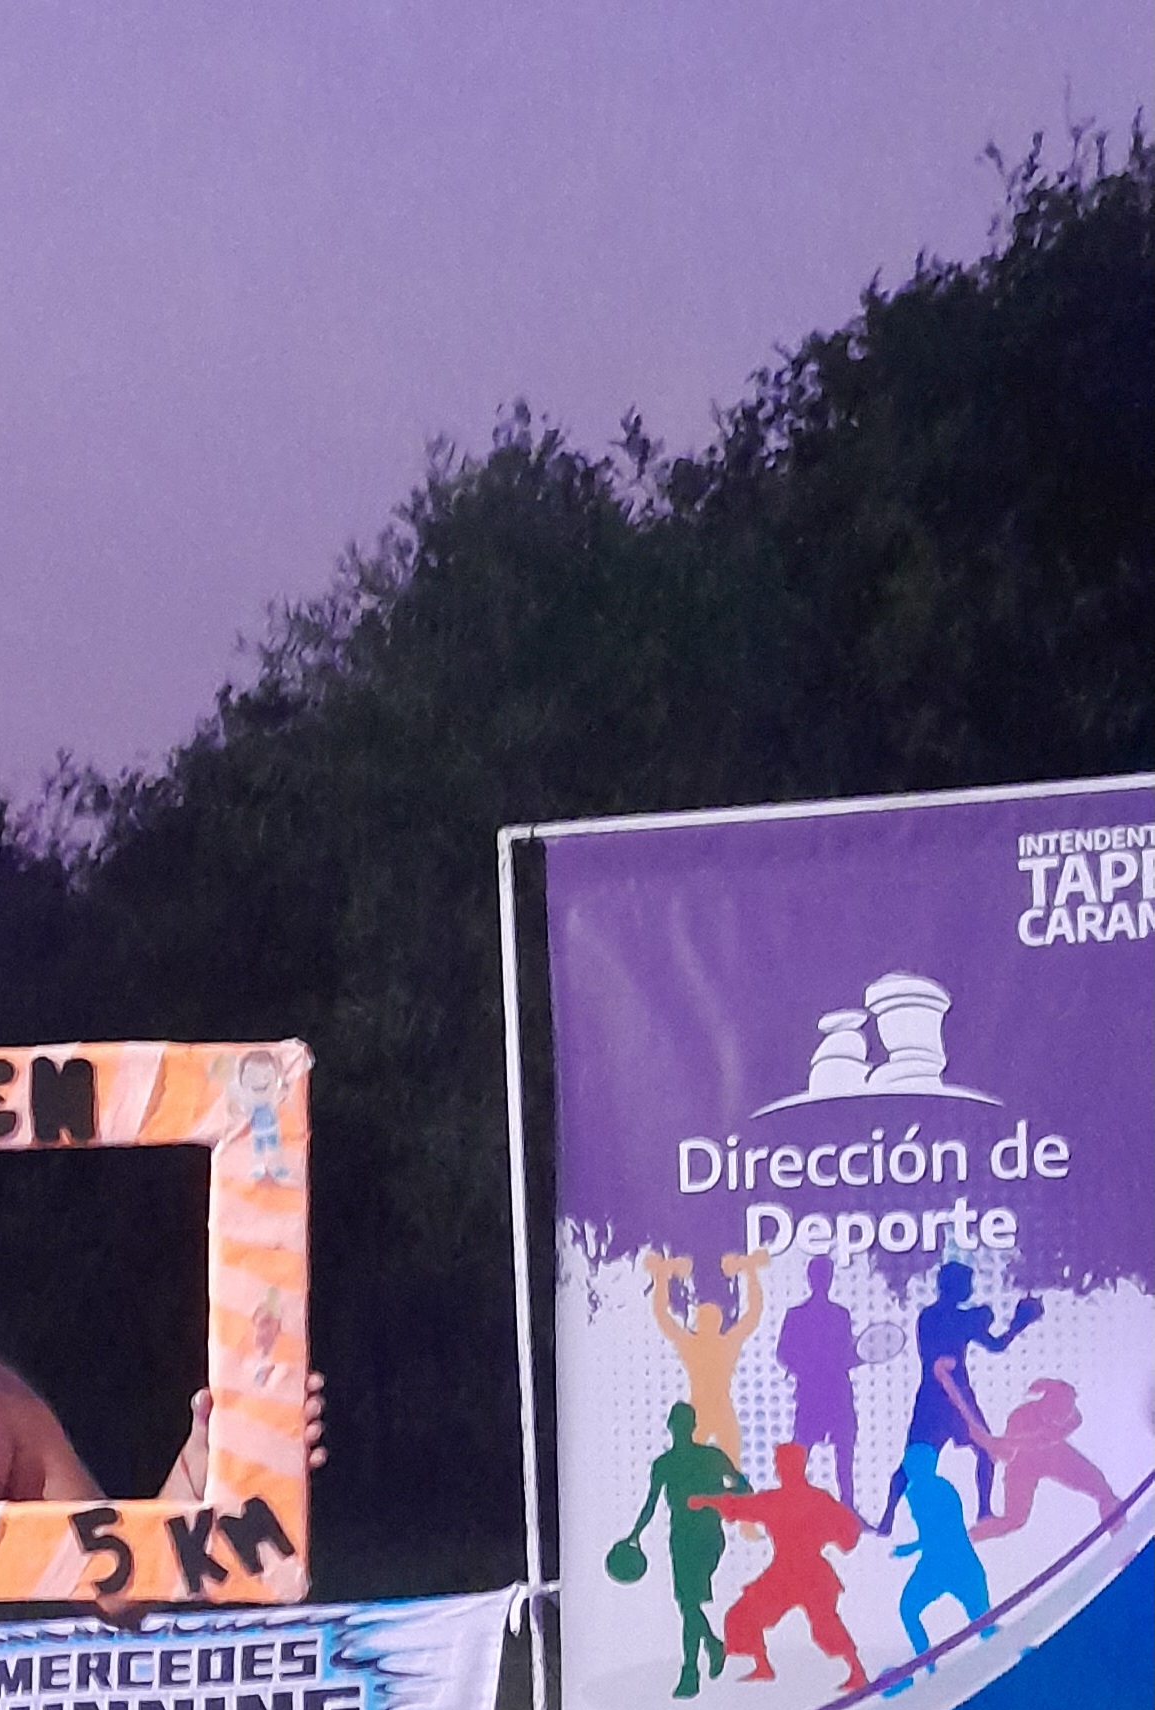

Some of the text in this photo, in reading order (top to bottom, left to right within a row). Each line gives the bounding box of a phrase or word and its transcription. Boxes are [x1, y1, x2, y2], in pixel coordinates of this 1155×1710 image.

[677, 1119, 1071, 1193] Dirección de
[745, 1197, 1018, 1266] Deporte
[70, 1507, 132, 1595] 5
[167, 1497, 295, 1596] KM
